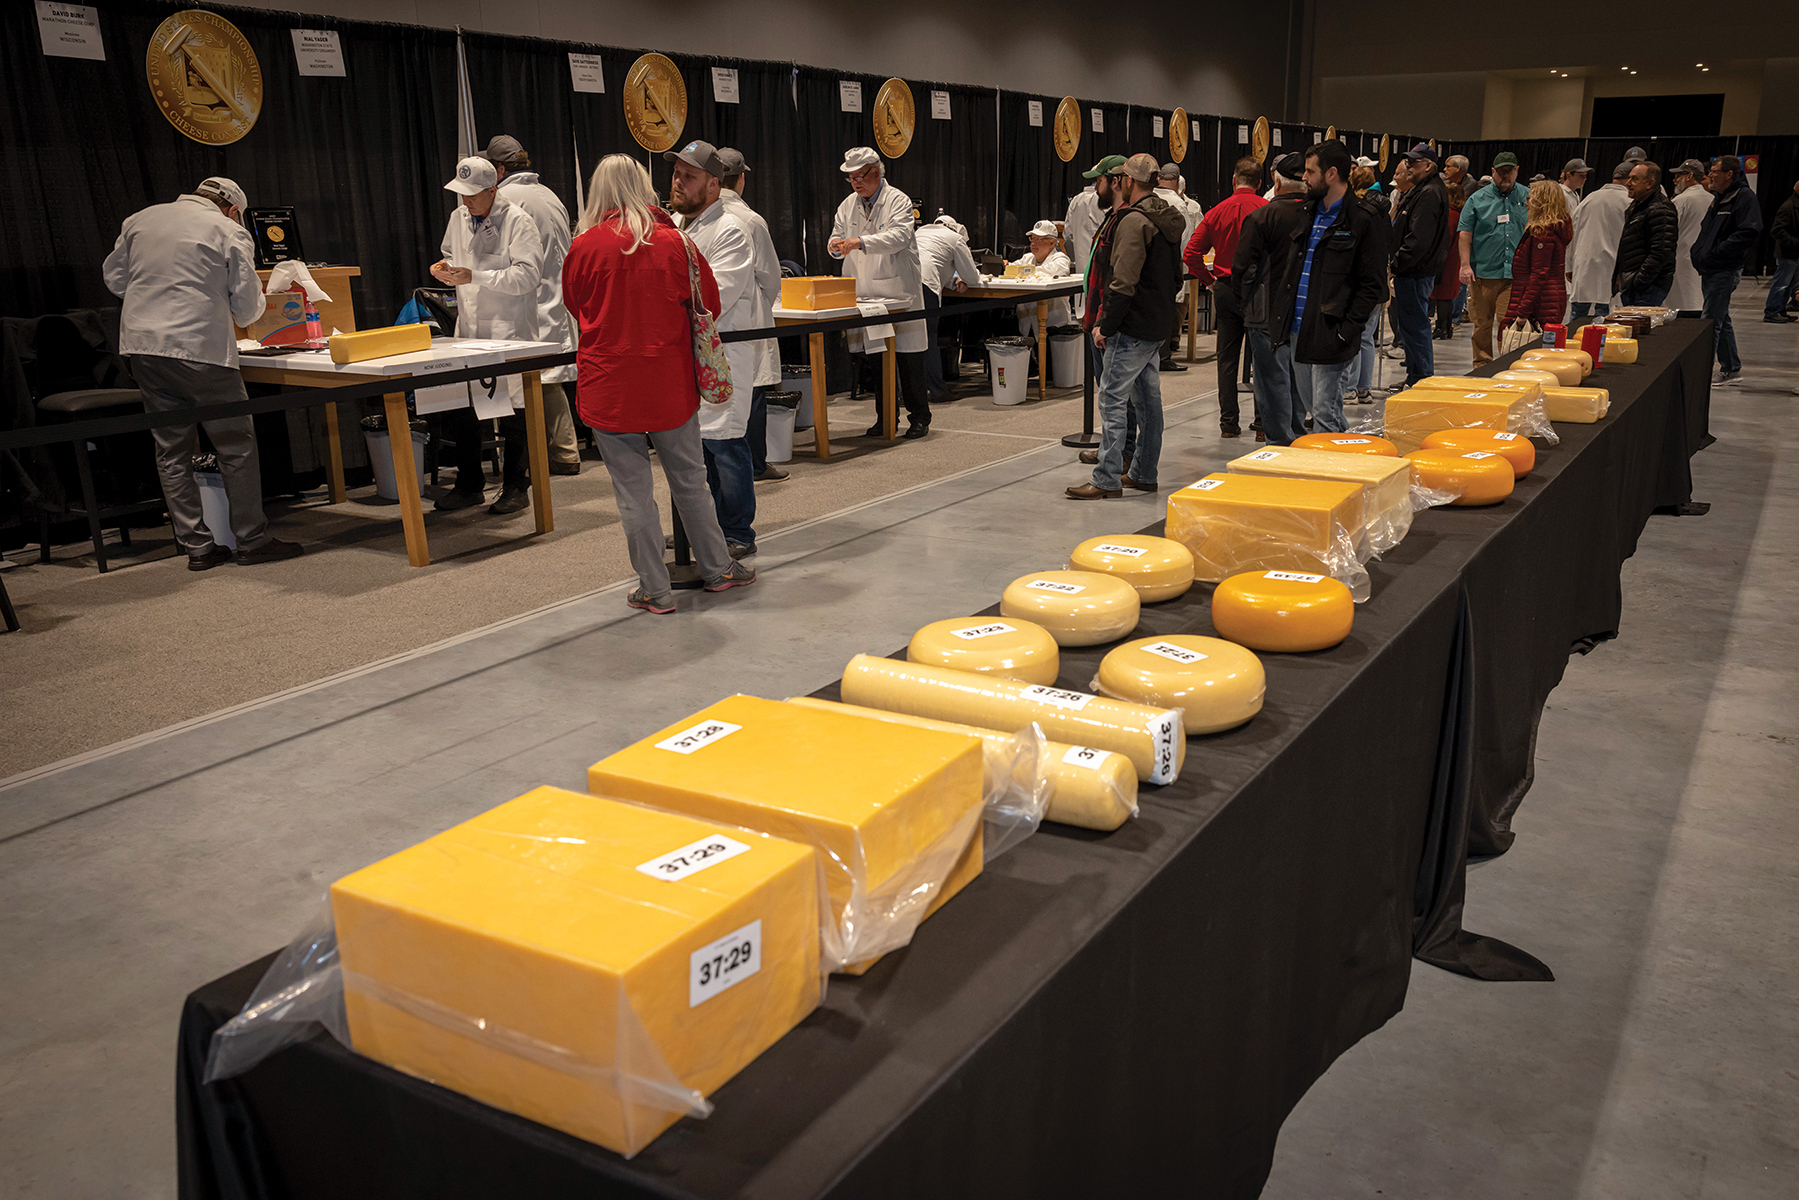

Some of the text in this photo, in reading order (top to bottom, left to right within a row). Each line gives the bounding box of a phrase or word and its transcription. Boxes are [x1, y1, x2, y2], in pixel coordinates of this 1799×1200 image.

[41, 16, 67, 24] MARATHON
[151, 13, 260, 86] UNITED STATES CHAMPIONSHIP
[169, 110, 252, 141] CHEESE CONTEST
[633, 127, 655, 149] CHEESE
[479, 376, 497, 400] 9
[1101, 545, 1138, 554] 37:20
[1034, 582, 1076, 592] 37:22
[962, 625, 1005, 637] 37:23
[1032, 687, 1083, 702] 37:26
[674, 725, 724, 748] 37:28
[658, 843, 726, 874] 37:29
[699, 939, 752, 987] 37:29
